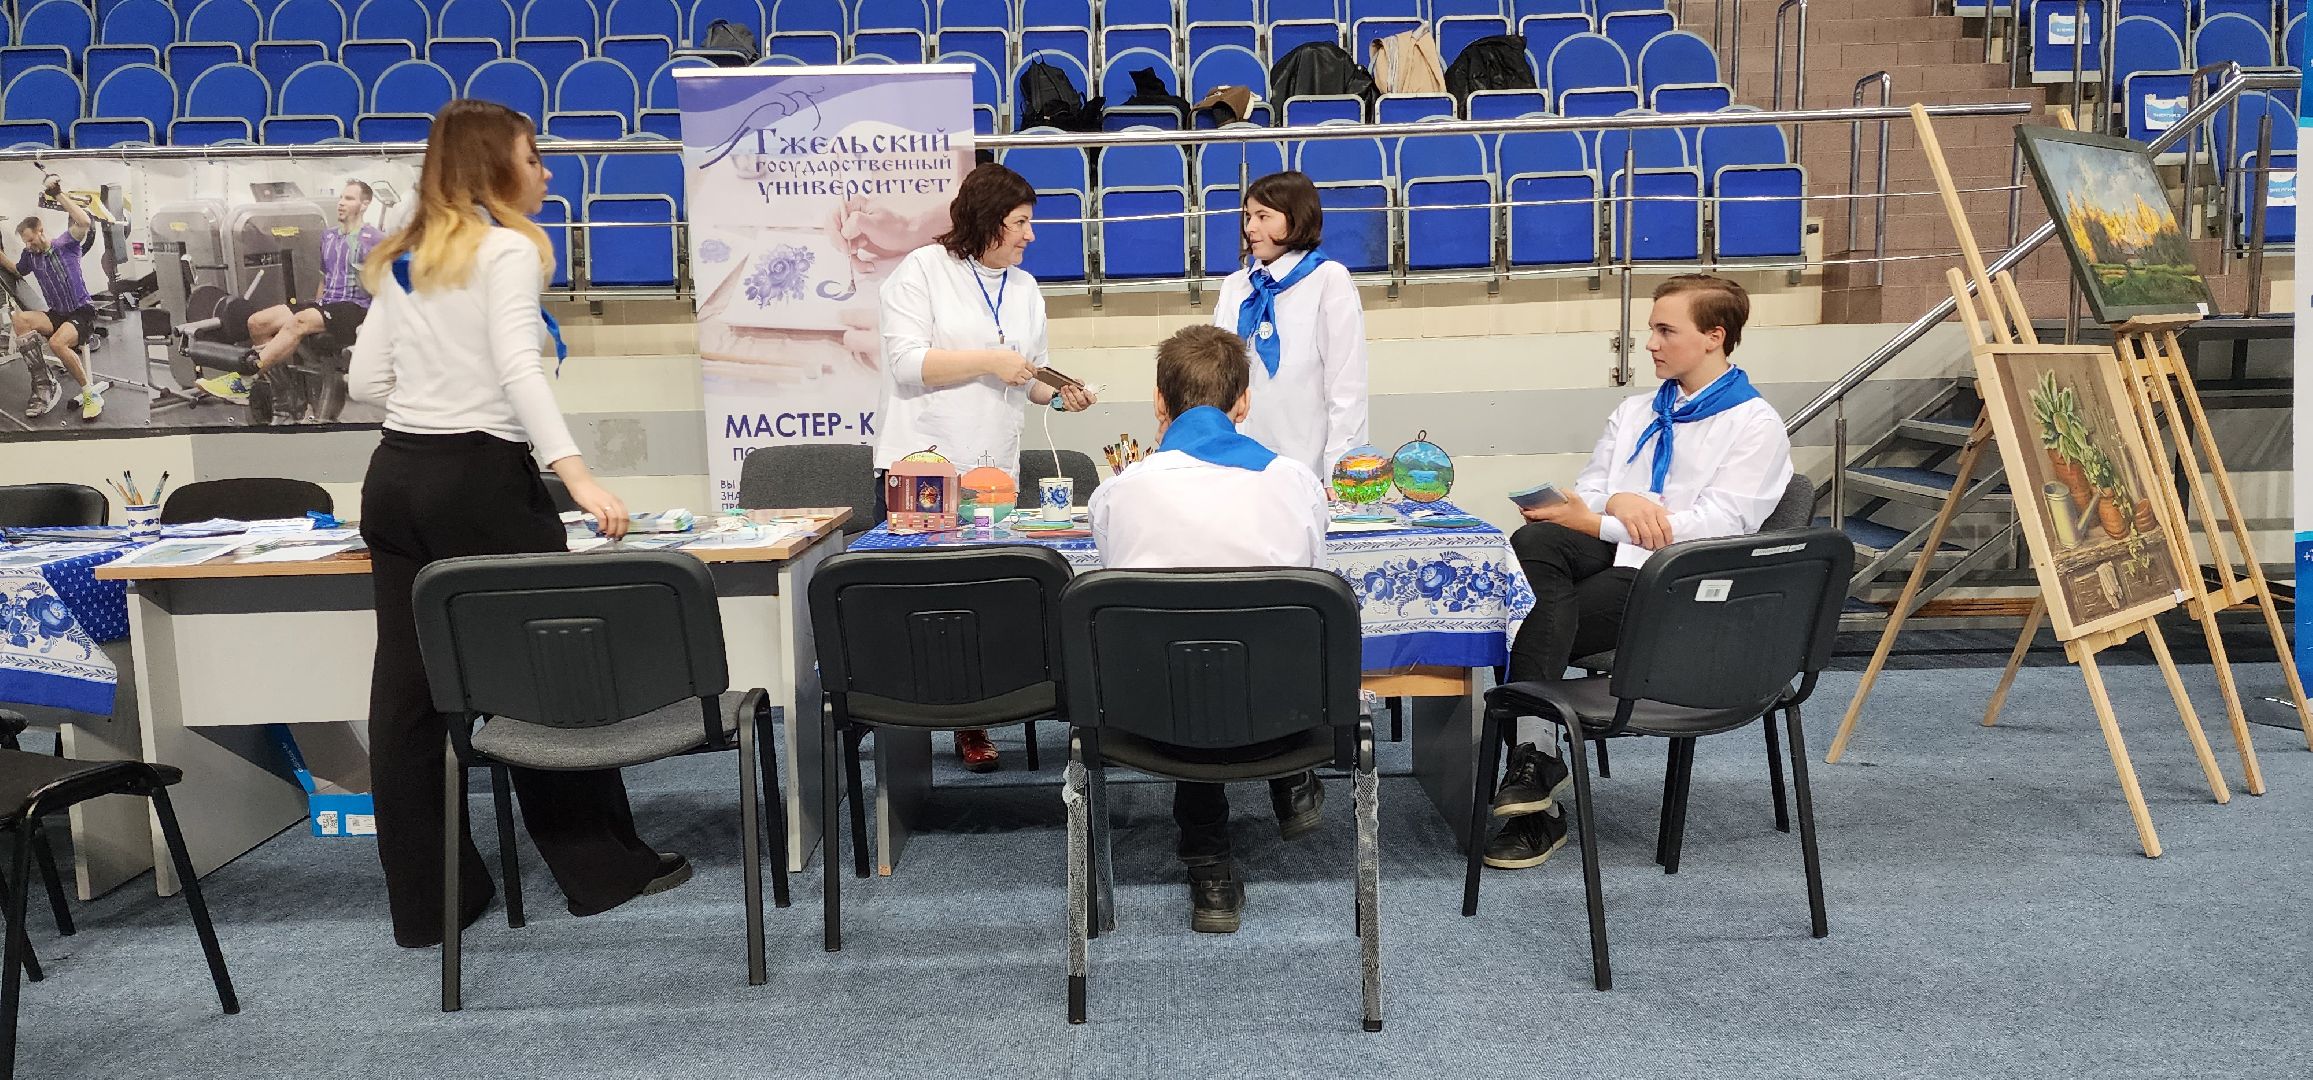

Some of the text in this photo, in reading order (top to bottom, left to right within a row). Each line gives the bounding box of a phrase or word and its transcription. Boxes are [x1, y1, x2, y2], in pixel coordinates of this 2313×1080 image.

[755, 128, 950, 154] Гжельский
[755, 153, 951, 178] государственный
[758, 178, 951, 203] университет
